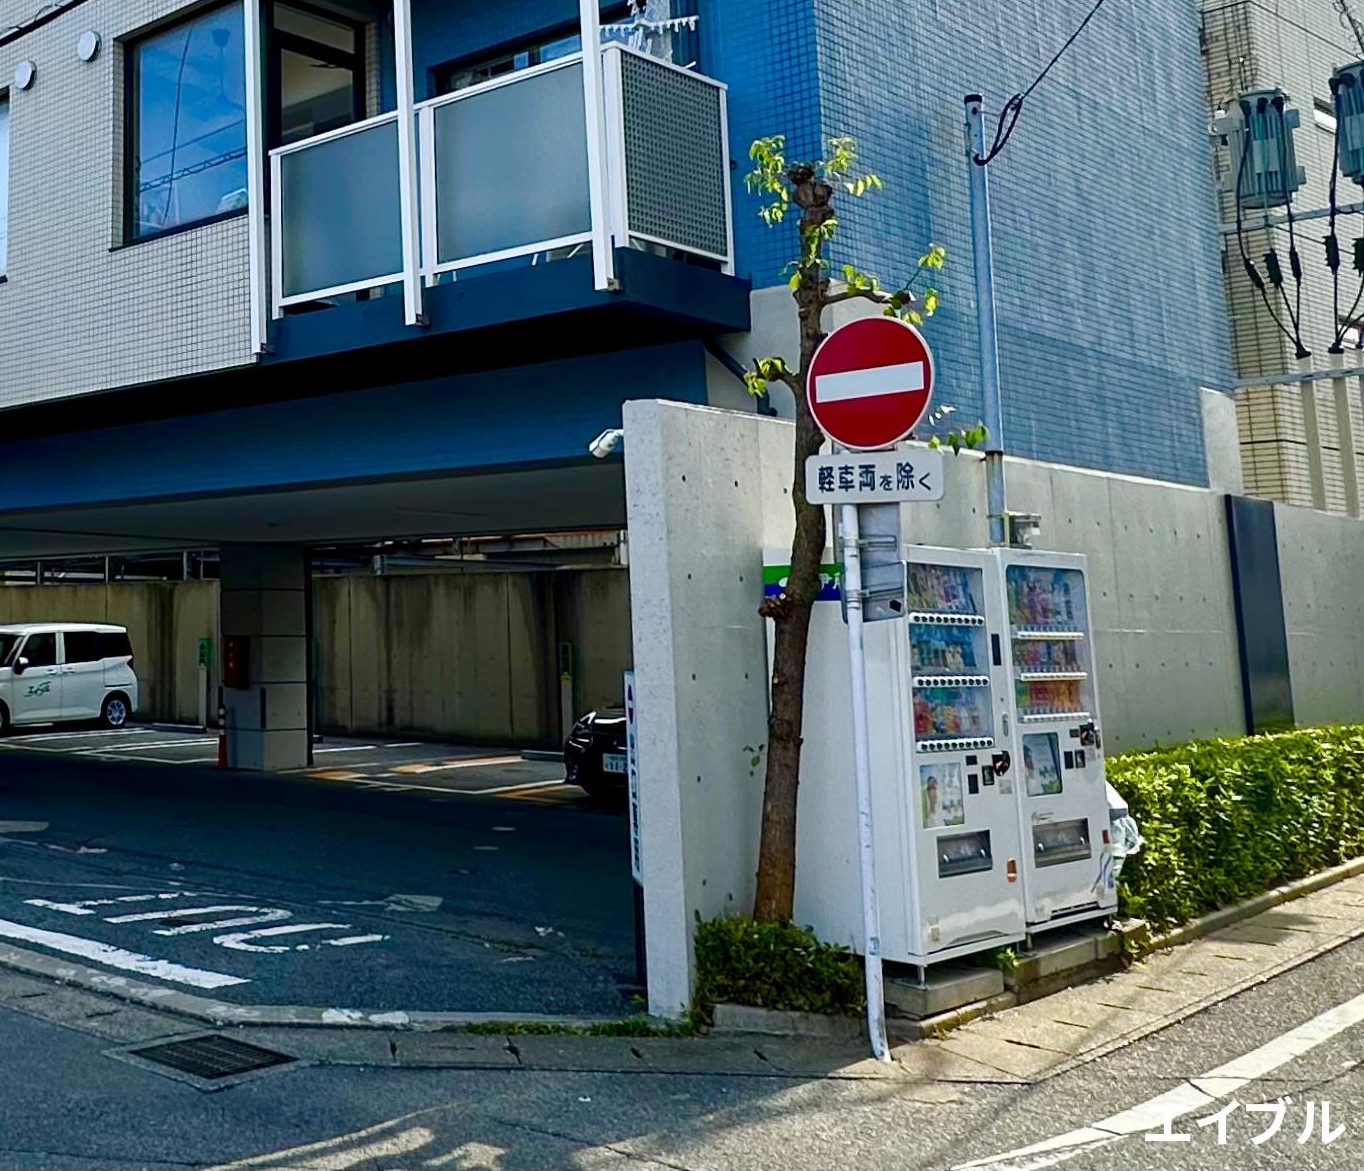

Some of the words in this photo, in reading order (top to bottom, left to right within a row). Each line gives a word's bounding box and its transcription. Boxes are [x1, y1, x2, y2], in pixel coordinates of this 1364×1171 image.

[818, 462, 932, 493] 軽車両を除く
